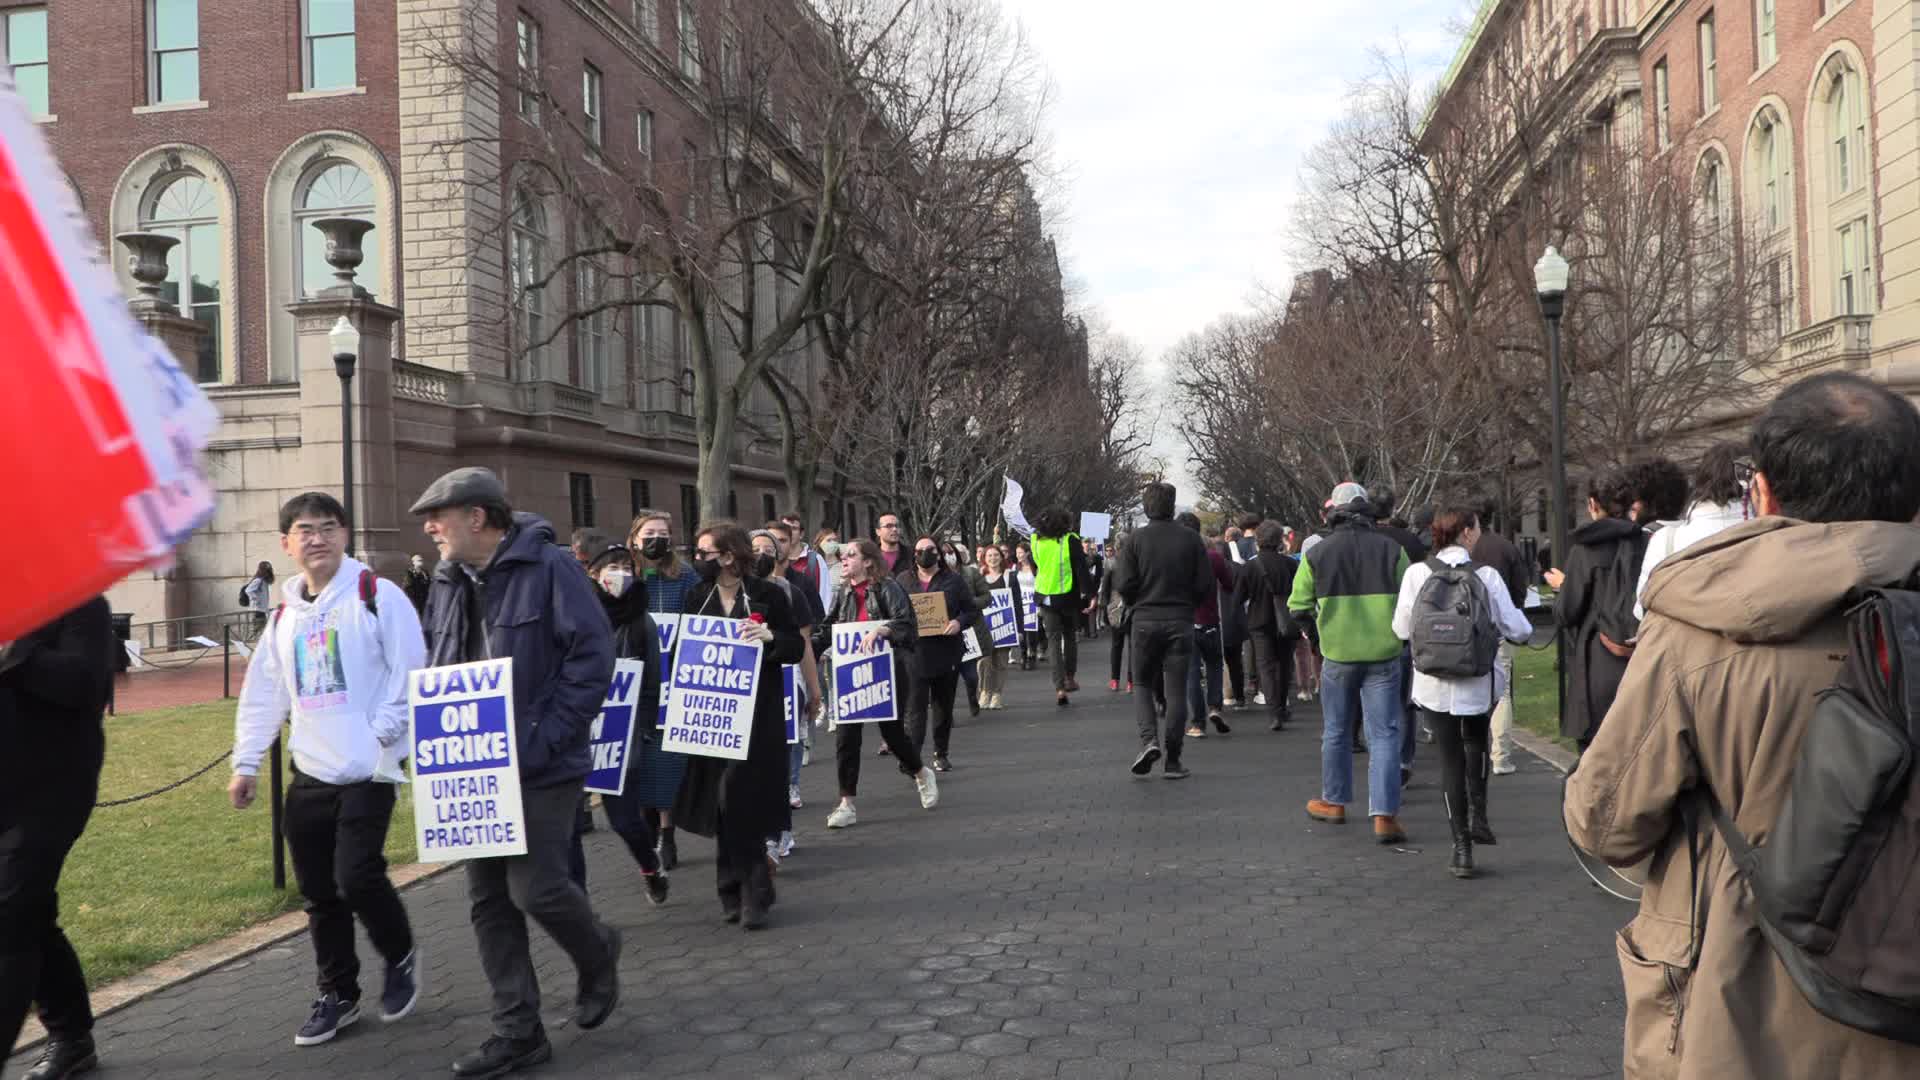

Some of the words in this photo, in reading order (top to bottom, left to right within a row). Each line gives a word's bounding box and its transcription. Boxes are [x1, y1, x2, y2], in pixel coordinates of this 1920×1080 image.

[989, 593, 1009, 608] AW
[702, 643, 734, 667] ON
[418, 664, 503, 699] UAW
[677, 663, 753, 691] STRIKE
[852, 661, 874, 689] ON
[683, 693, 738, 714] UNFAIR
[838, 679, 891, 718] STRIKE
[440, 702, 479, 733] ON
[590, 711, 606, 741] N
[684, 711, 733, 731] LABOR
[416, 732, 508, 768] STRIKE
[669, 726, 743, 750] PRACTICE
[431, 774, 499, 801] UNFAIR
[436, 799, 498, 824] LABOR
[425, 822, 516, 849] PRACTICE
